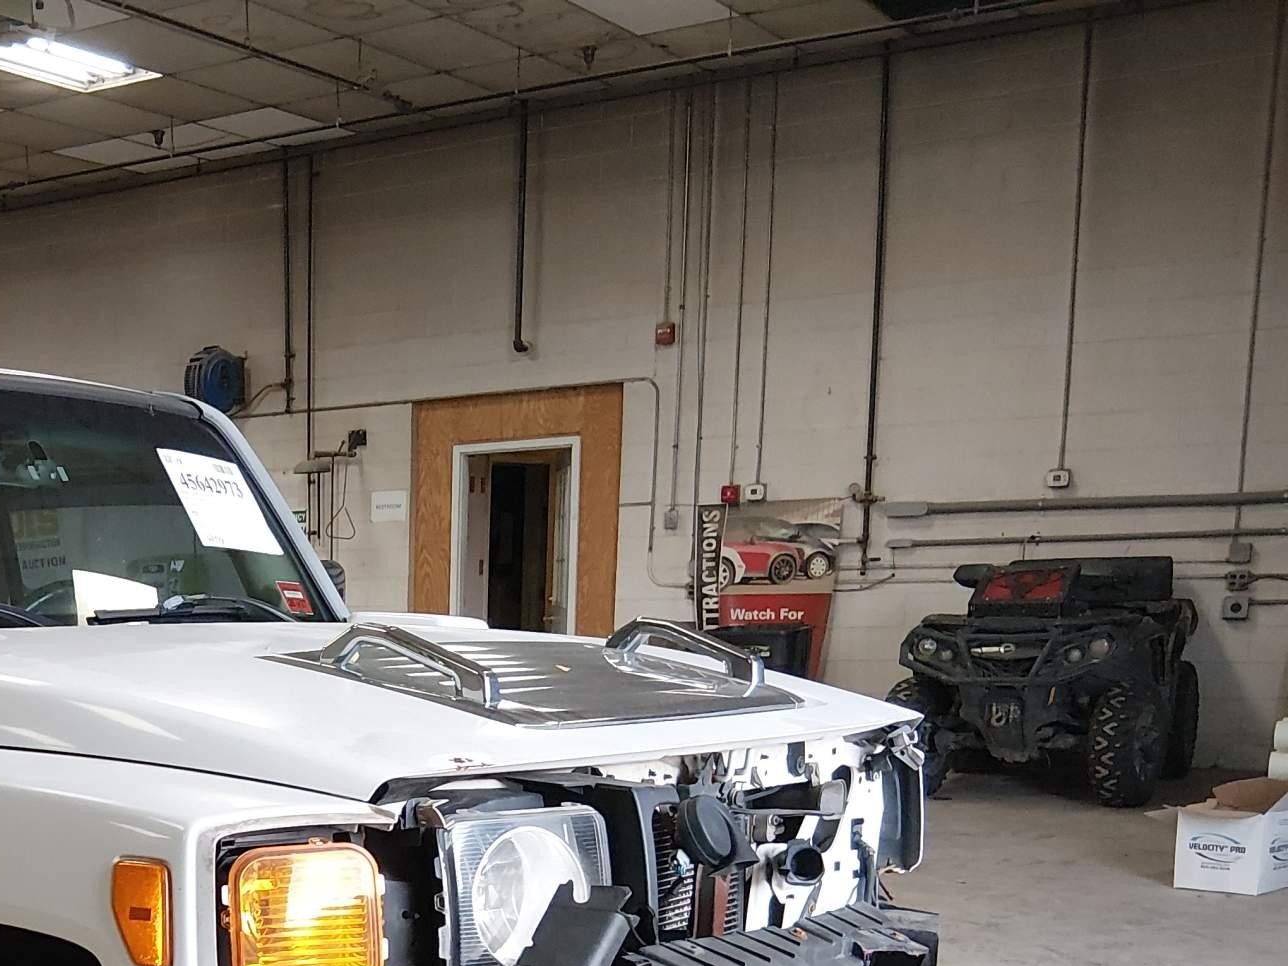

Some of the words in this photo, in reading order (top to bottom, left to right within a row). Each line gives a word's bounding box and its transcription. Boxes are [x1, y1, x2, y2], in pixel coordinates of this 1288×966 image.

[179, 472, 244, 498] 45642973
[22, 556, 66, 570] AUCTION
[730, 608, 775, 620] Watch
[780, 608, 804, 620] For
[1230, 846, 1246, 854] PRO
